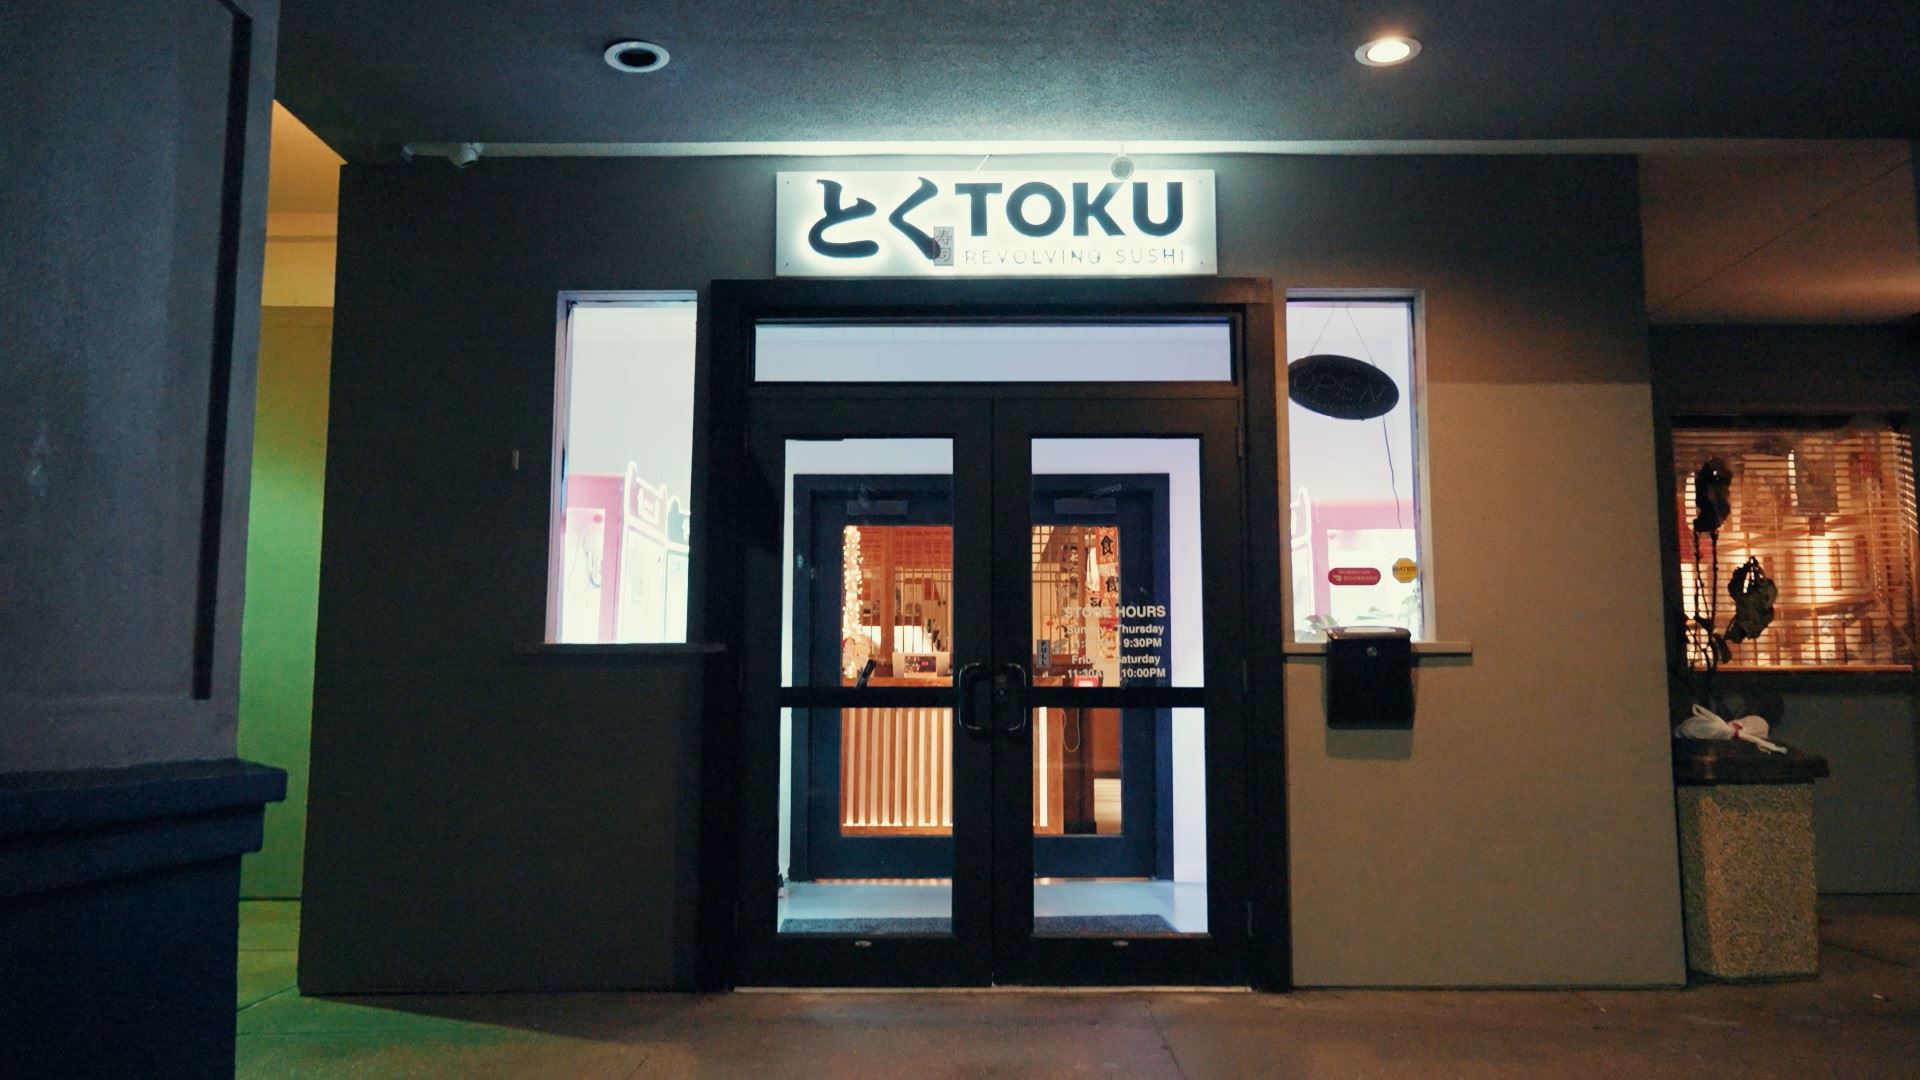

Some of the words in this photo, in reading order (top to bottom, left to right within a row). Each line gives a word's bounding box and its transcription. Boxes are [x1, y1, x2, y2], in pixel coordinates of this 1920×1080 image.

[954, 182, 1184, 237] TOKU
[808, 177, 941, 260] とく
[965, 248, 1101, 264] REVOLVING
[1115, 248, 1184, 264] SUSHI
[1117, 605, 1166, 618] HOURS
[1115, 624, 1165, 636] Thursday
[1123, 638, 1163, 648] 9:30PM
[1122, 667, 1166, 679] 10:00PM
